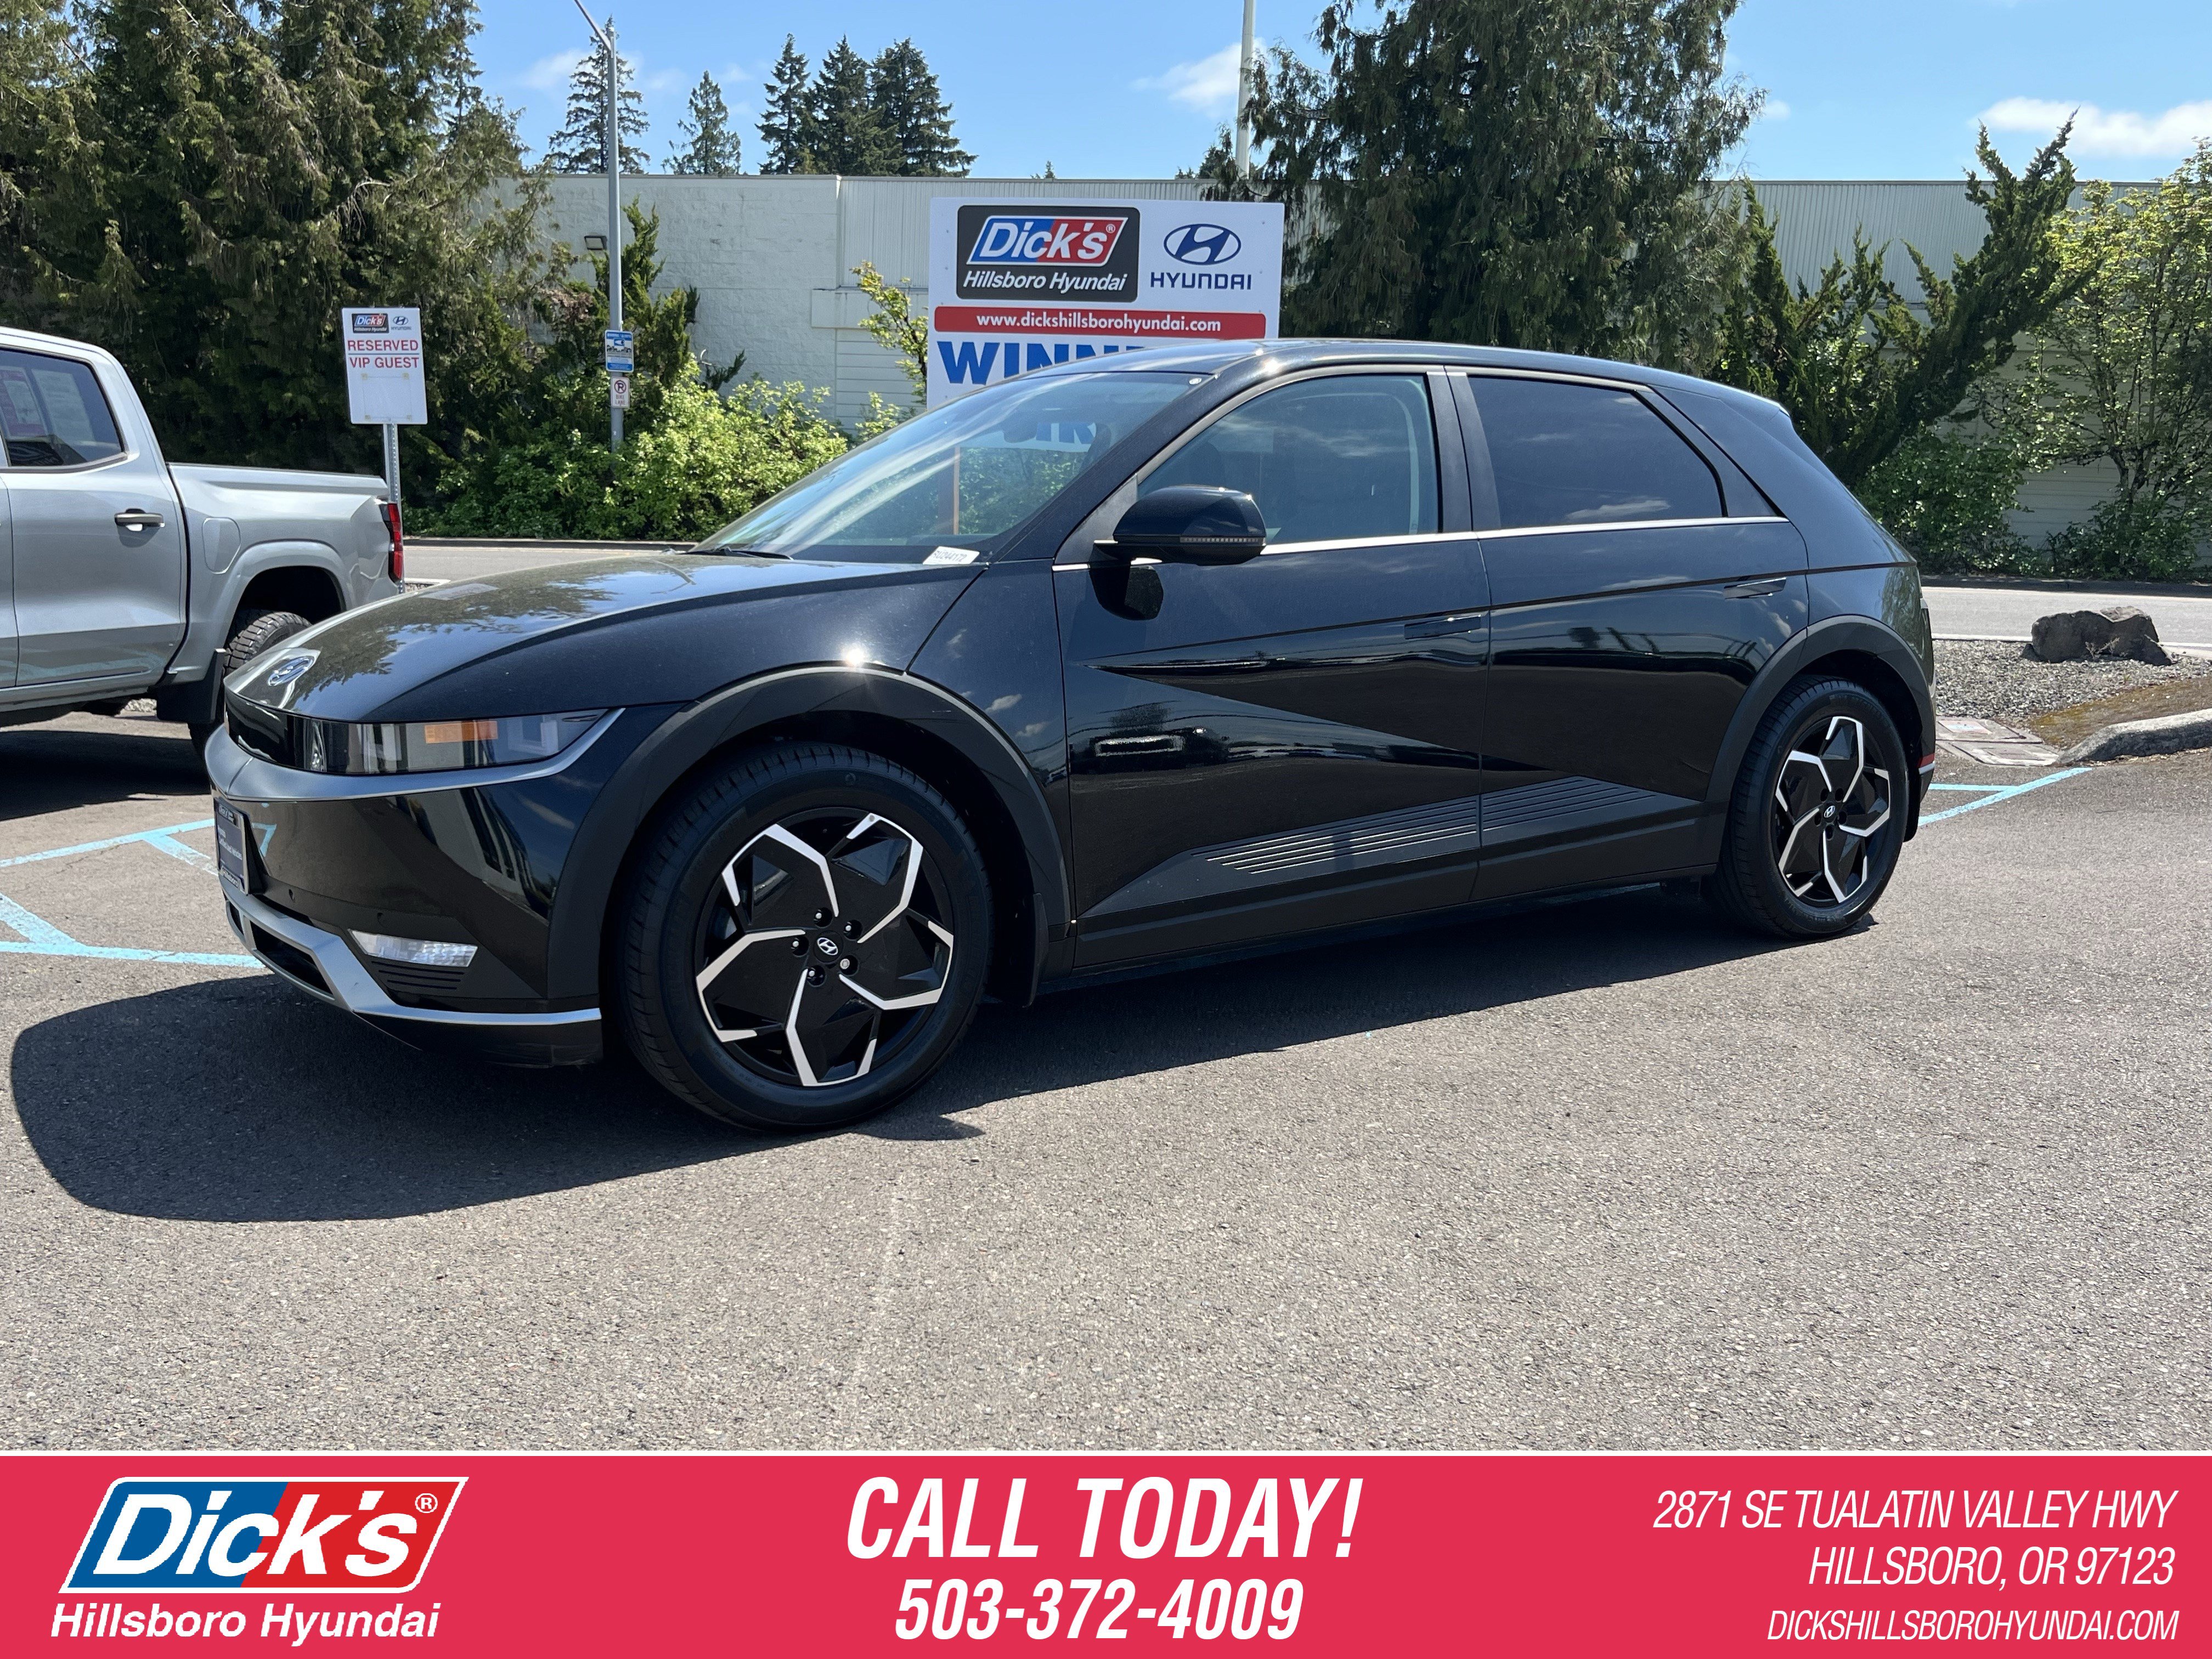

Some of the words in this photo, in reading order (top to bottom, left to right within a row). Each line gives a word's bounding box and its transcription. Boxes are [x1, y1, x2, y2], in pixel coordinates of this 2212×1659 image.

[979, 221, 1107, 259] Dick's
[963, 270, 1046, 289] Hillsboro
[1049, 272, 1128, 294] Hyundai
[1150, 272, 1252, 290] HYUNDAI
[977, 311, 1221, 334] www.dickshillsborohyundai.com
[347, 340, 419, 352] RESERVED
[349, 357, 370, 368] VIP
[375, 357, 419, 368] GUEST
[937, 341, 1146, 385] WIN
